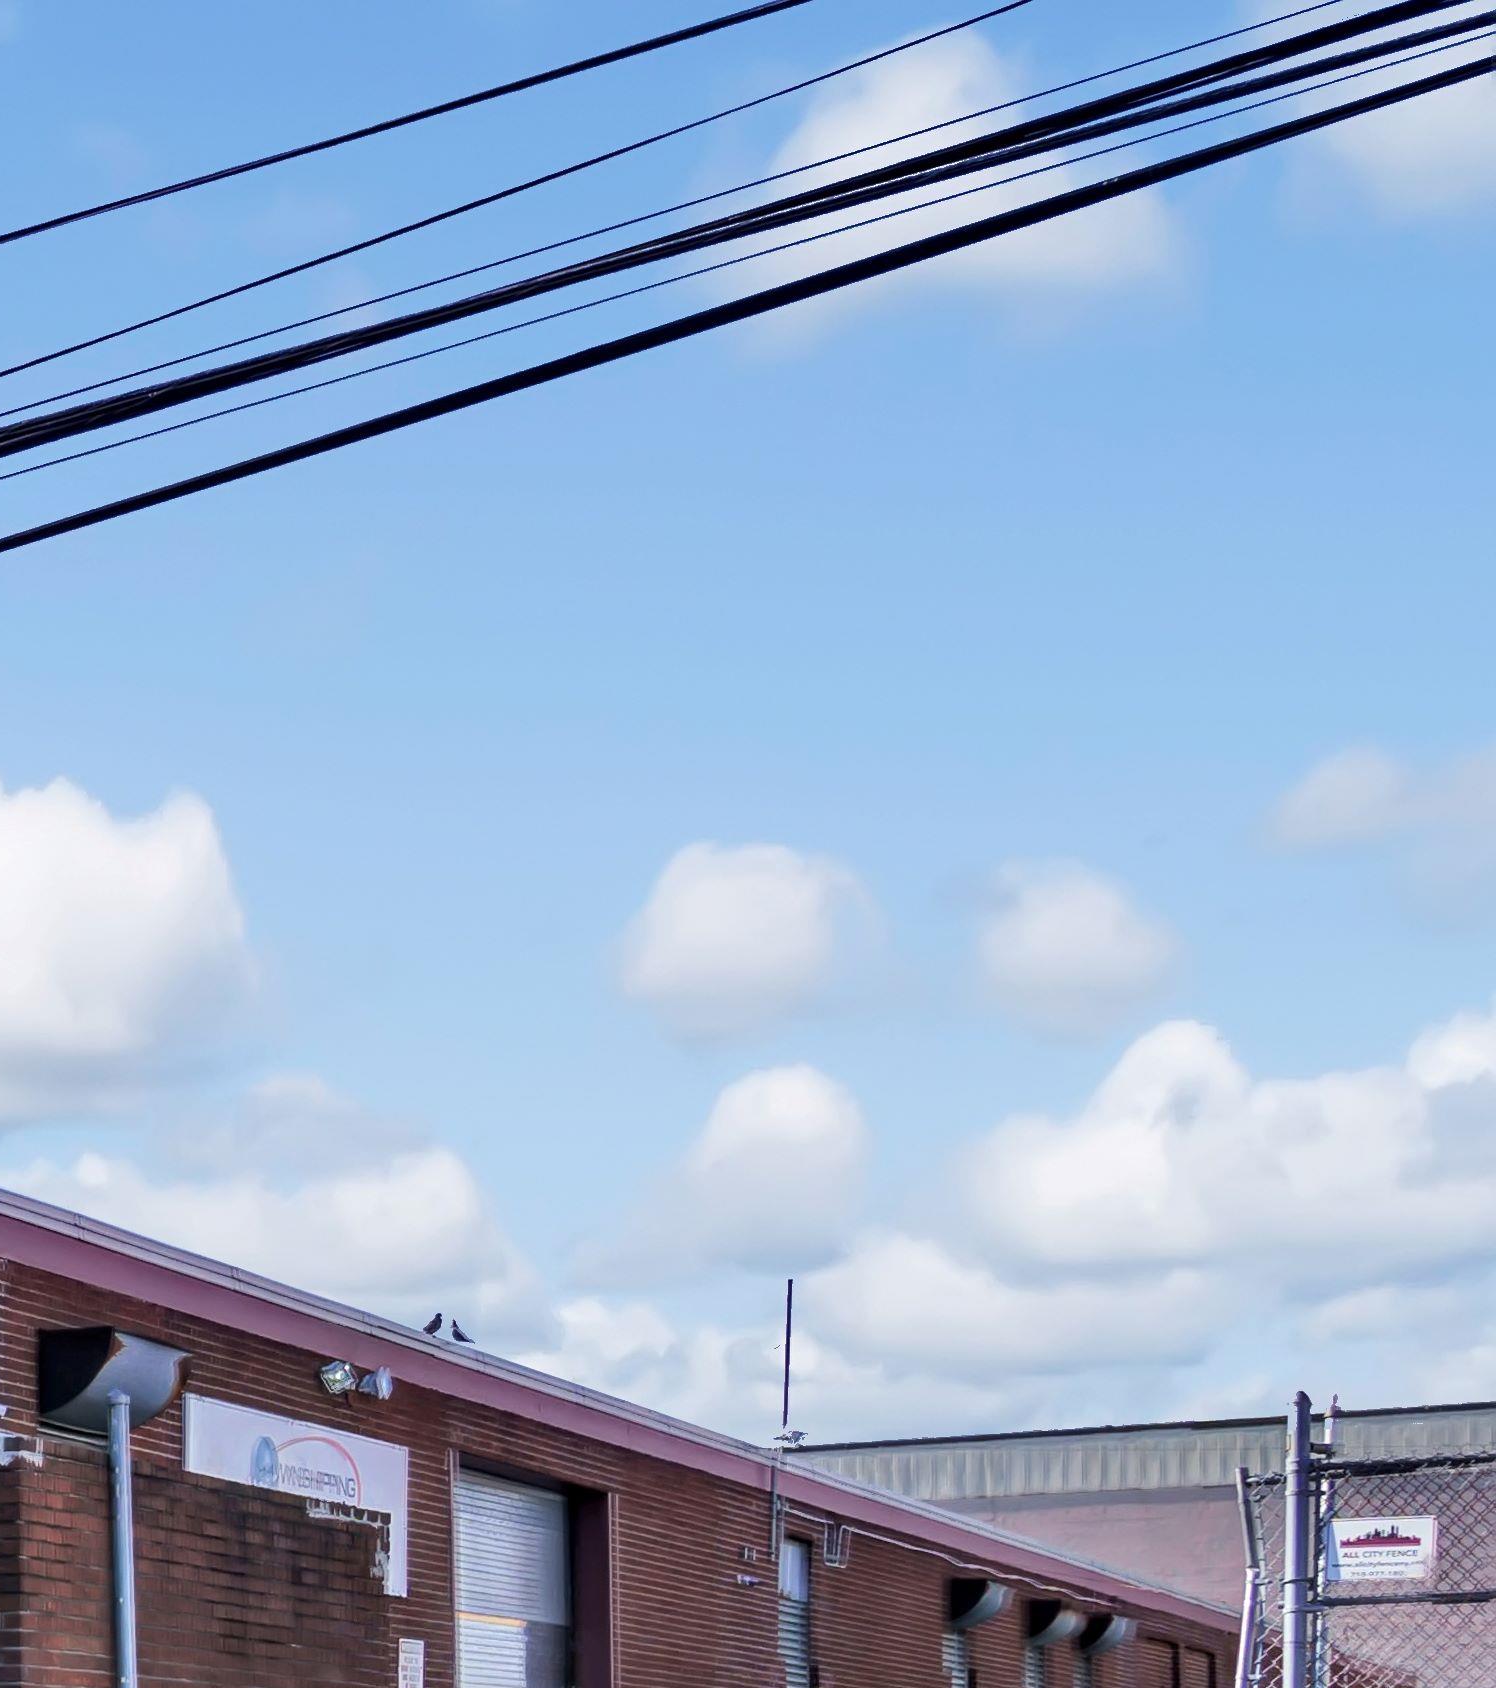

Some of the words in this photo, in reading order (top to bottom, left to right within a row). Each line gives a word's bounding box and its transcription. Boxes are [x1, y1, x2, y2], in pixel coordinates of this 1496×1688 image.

[1342, 1551, 1360, 1559] ALL
[1362, 1550, 1384, 1559] CITY
[1386, 1549, 1419, 1558] FENCE
